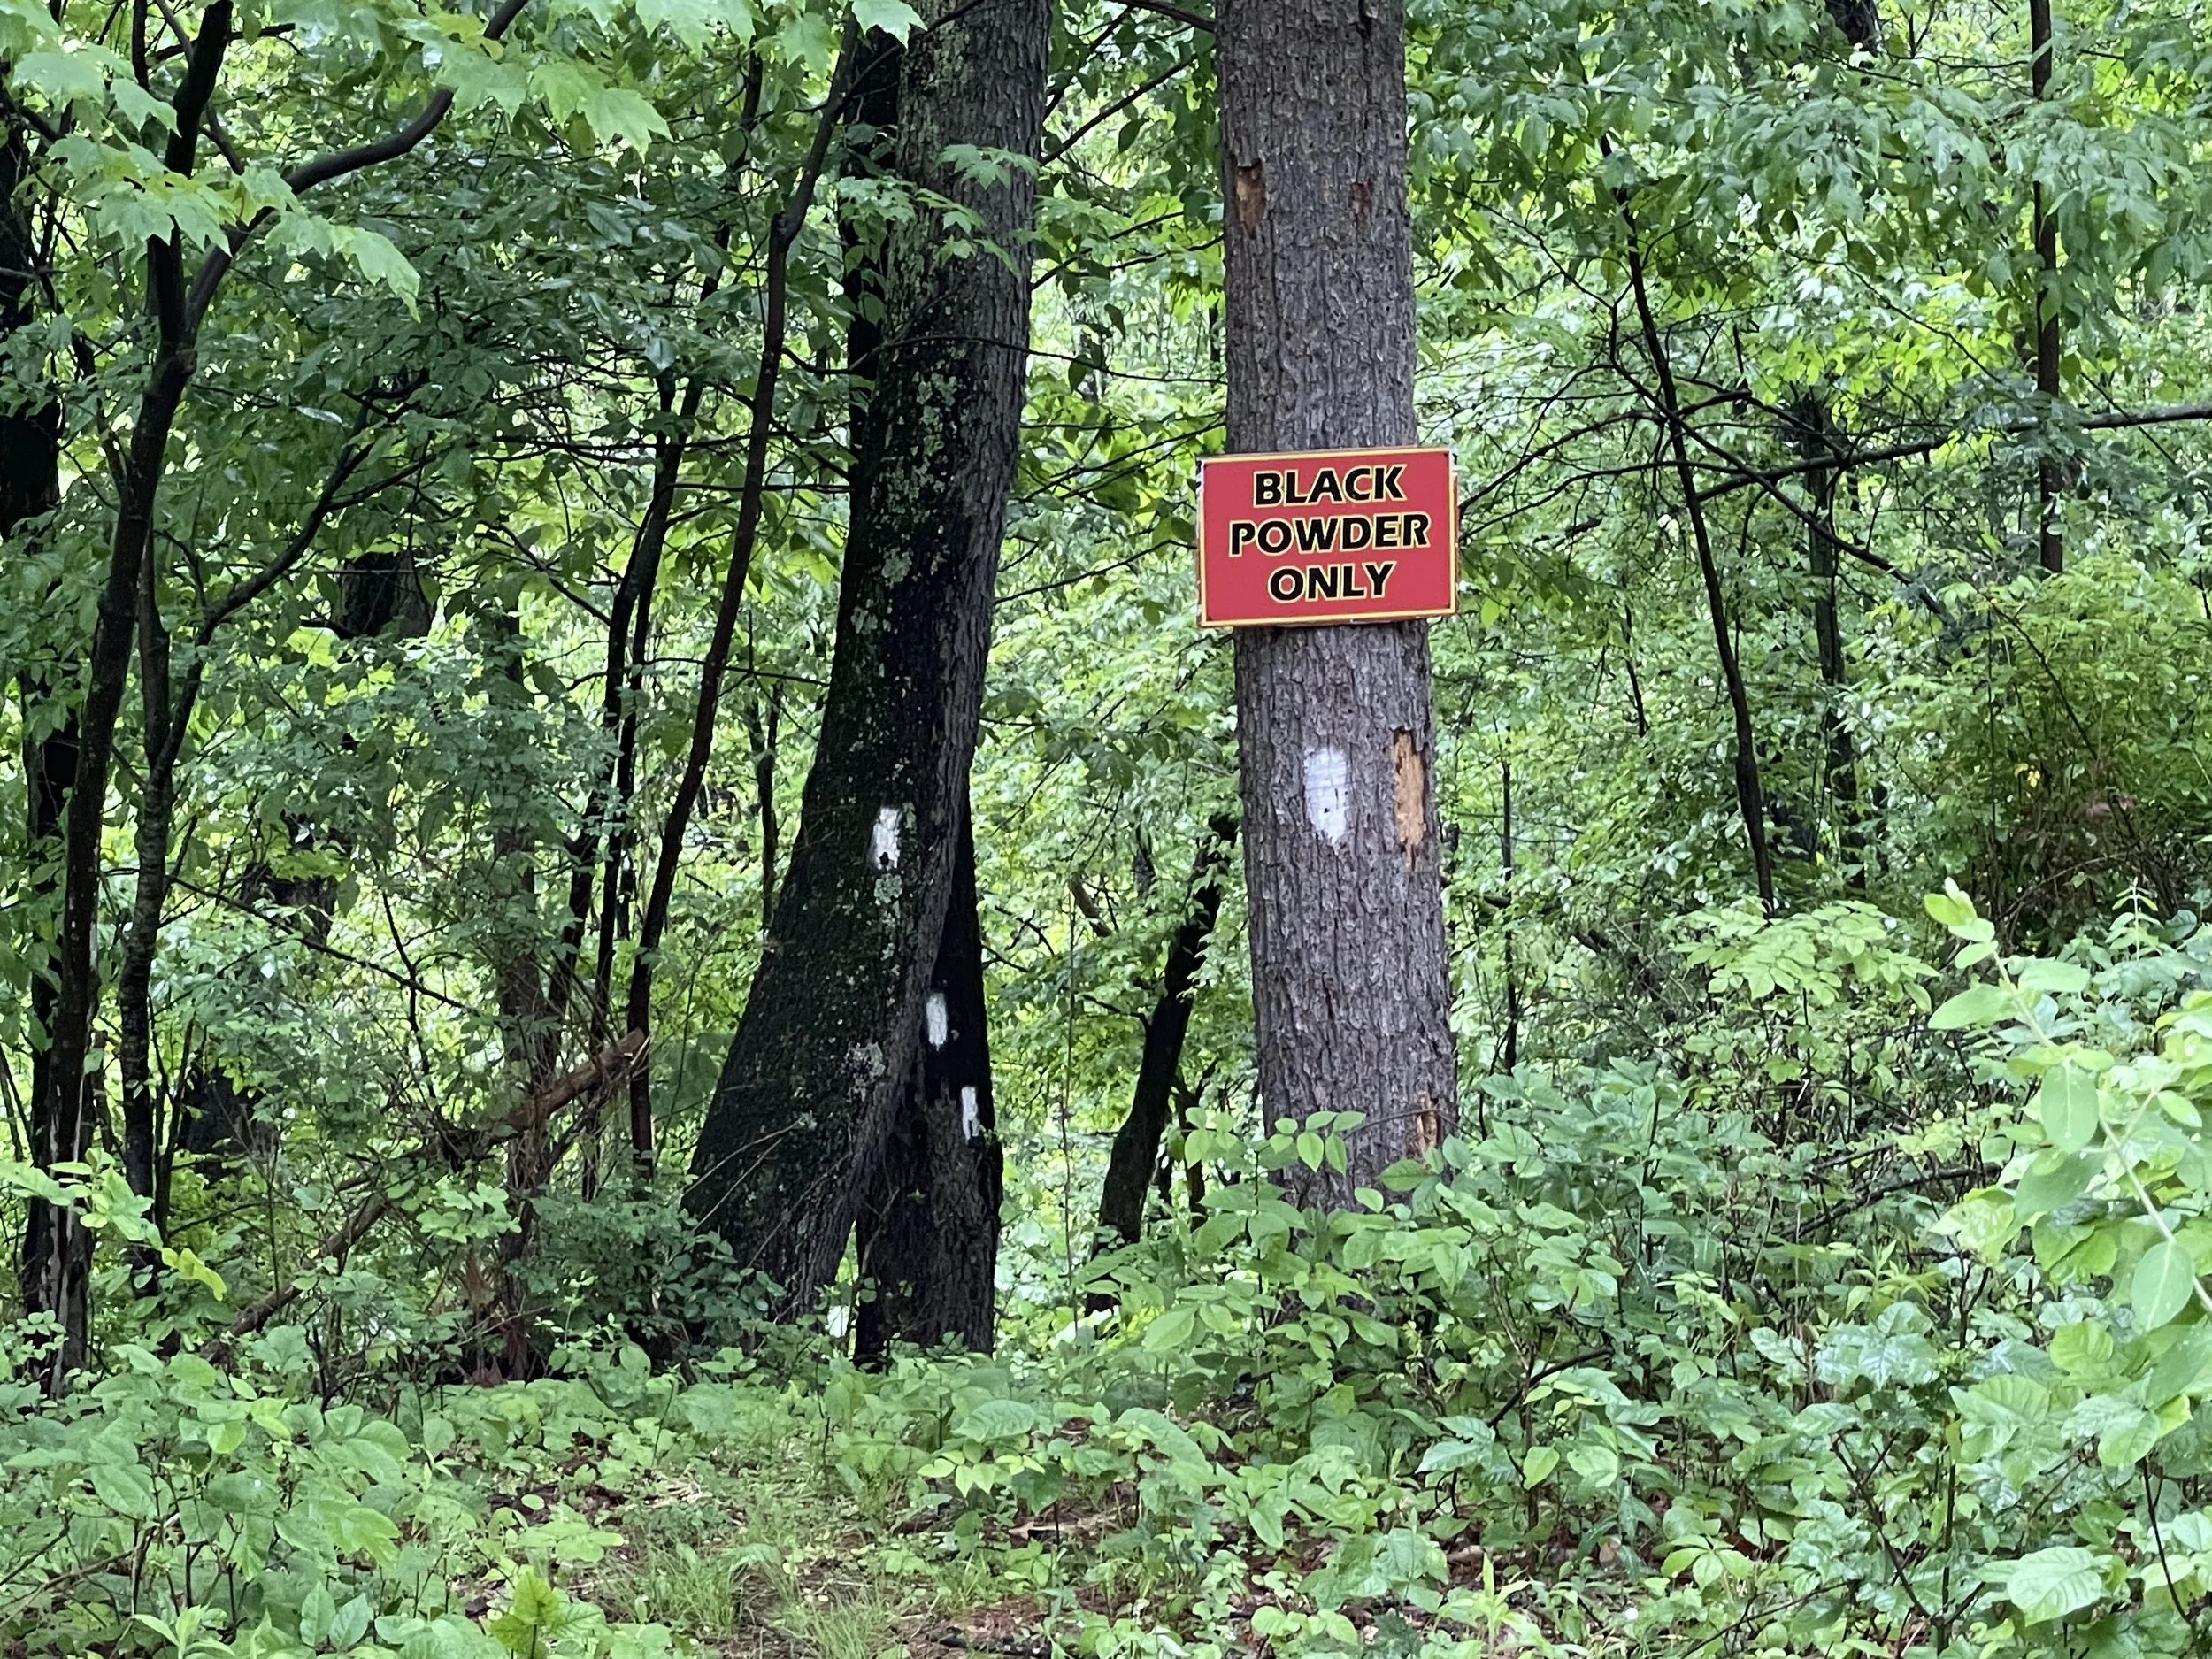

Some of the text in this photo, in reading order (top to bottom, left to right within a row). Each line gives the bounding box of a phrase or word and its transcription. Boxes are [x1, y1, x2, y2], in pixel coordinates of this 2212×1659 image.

[1253, 464, 1407, 508] BLACK
[1229, 511, 1432, 557] POWDER
[1267, 560, 1397, 603] ONLY
